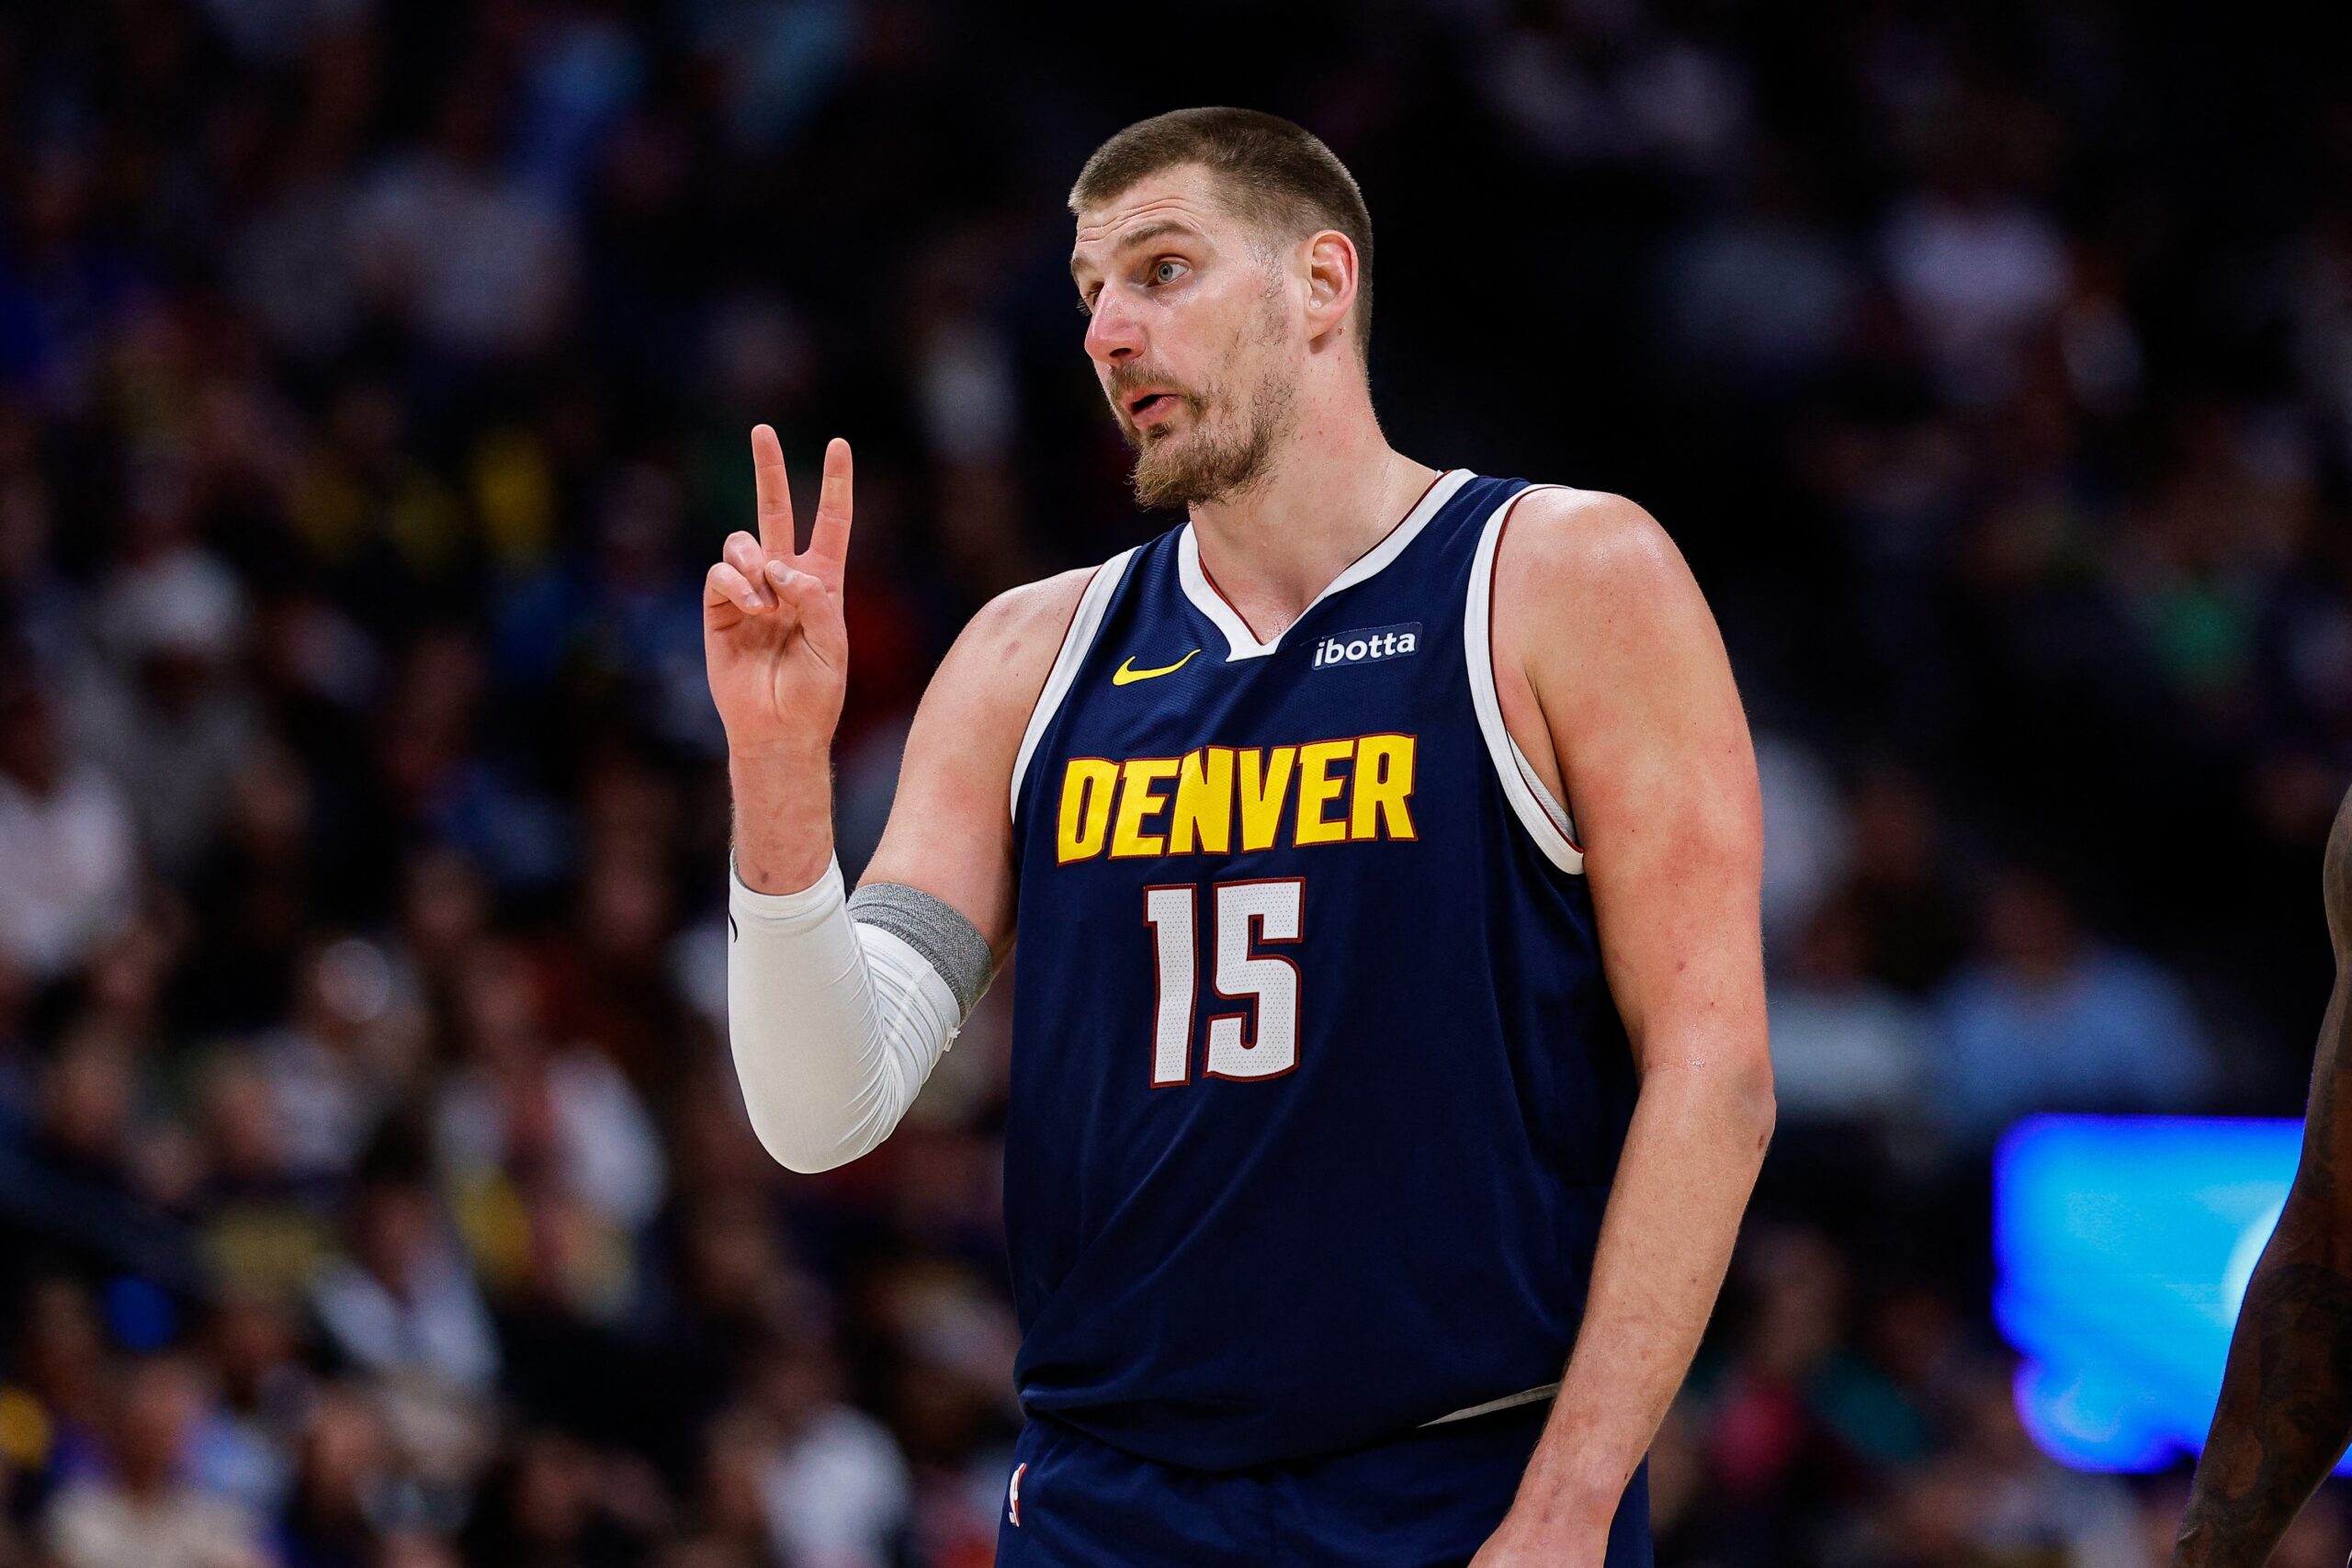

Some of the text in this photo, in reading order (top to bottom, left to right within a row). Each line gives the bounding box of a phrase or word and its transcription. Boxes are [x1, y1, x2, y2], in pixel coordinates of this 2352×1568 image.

[1314, 631, 1417, 667] ibotta
[1057, 732, 1419, 866] DENVER
[1143, 876, 1306, 1089] 15
